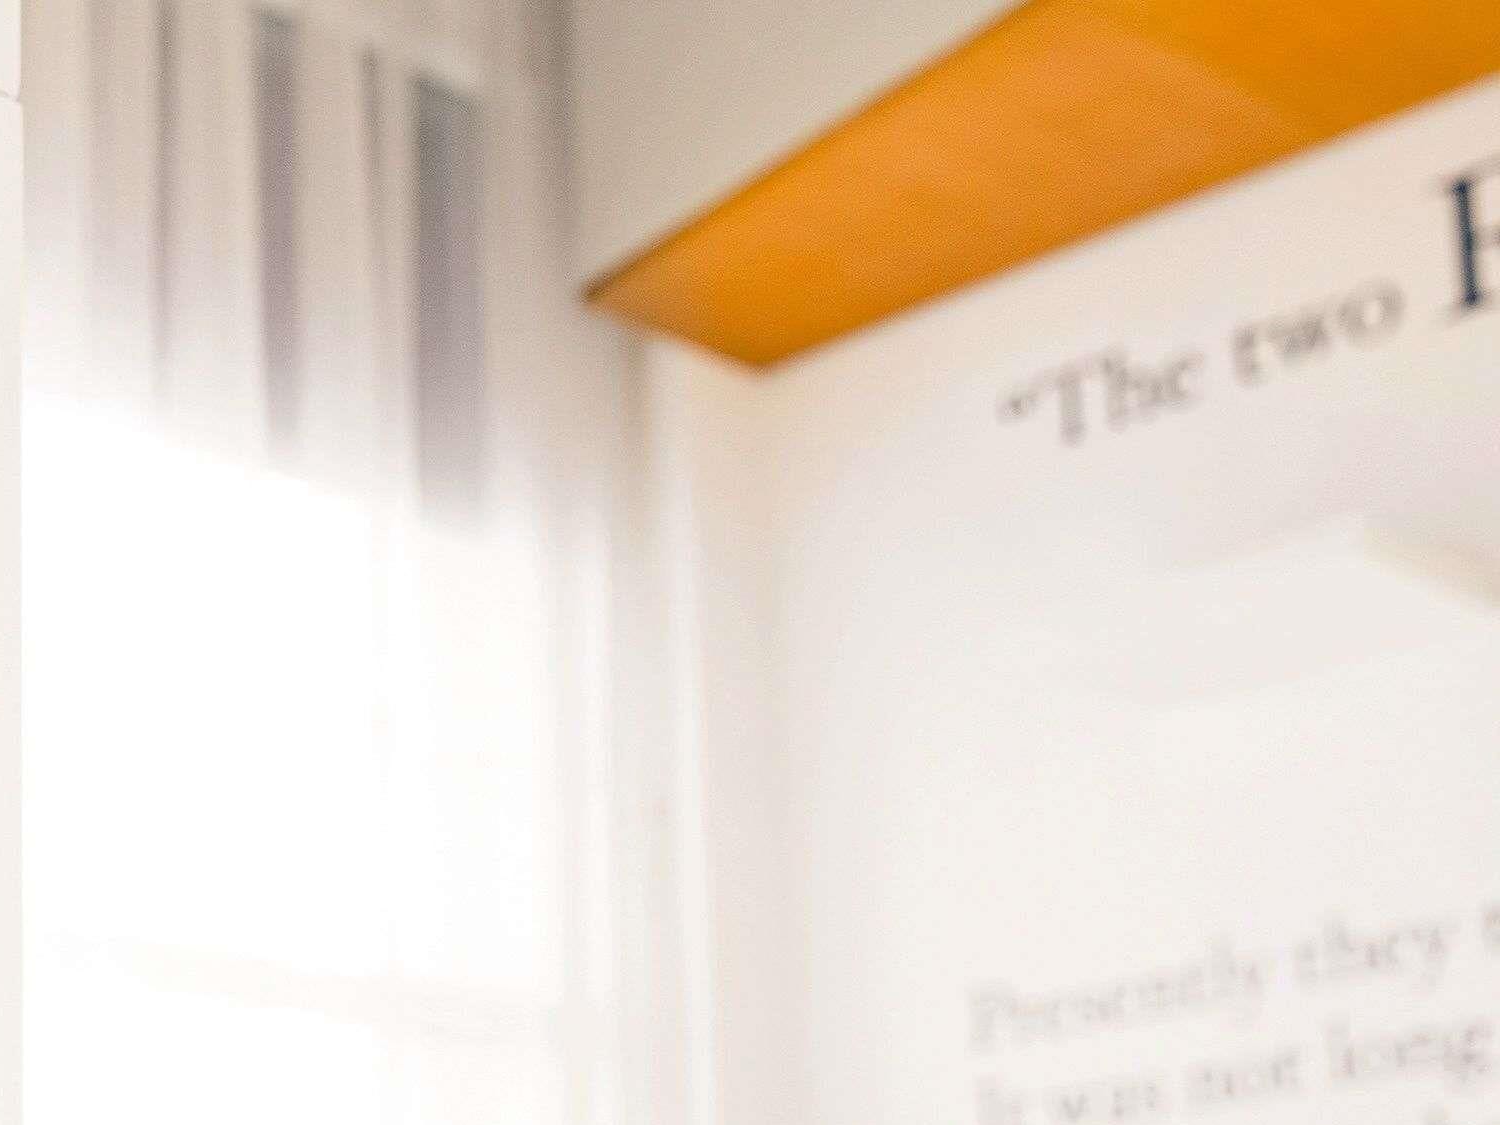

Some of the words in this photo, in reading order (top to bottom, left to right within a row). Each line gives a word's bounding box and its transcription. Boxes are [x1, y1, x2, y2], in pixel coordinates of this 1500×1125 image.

[1230, 278, 1405, 386] two
[1292, 908, 1458, 992] they
[1186, 1042, 1303, 1114] not
[1322, 1012, 1498, 1098] long
